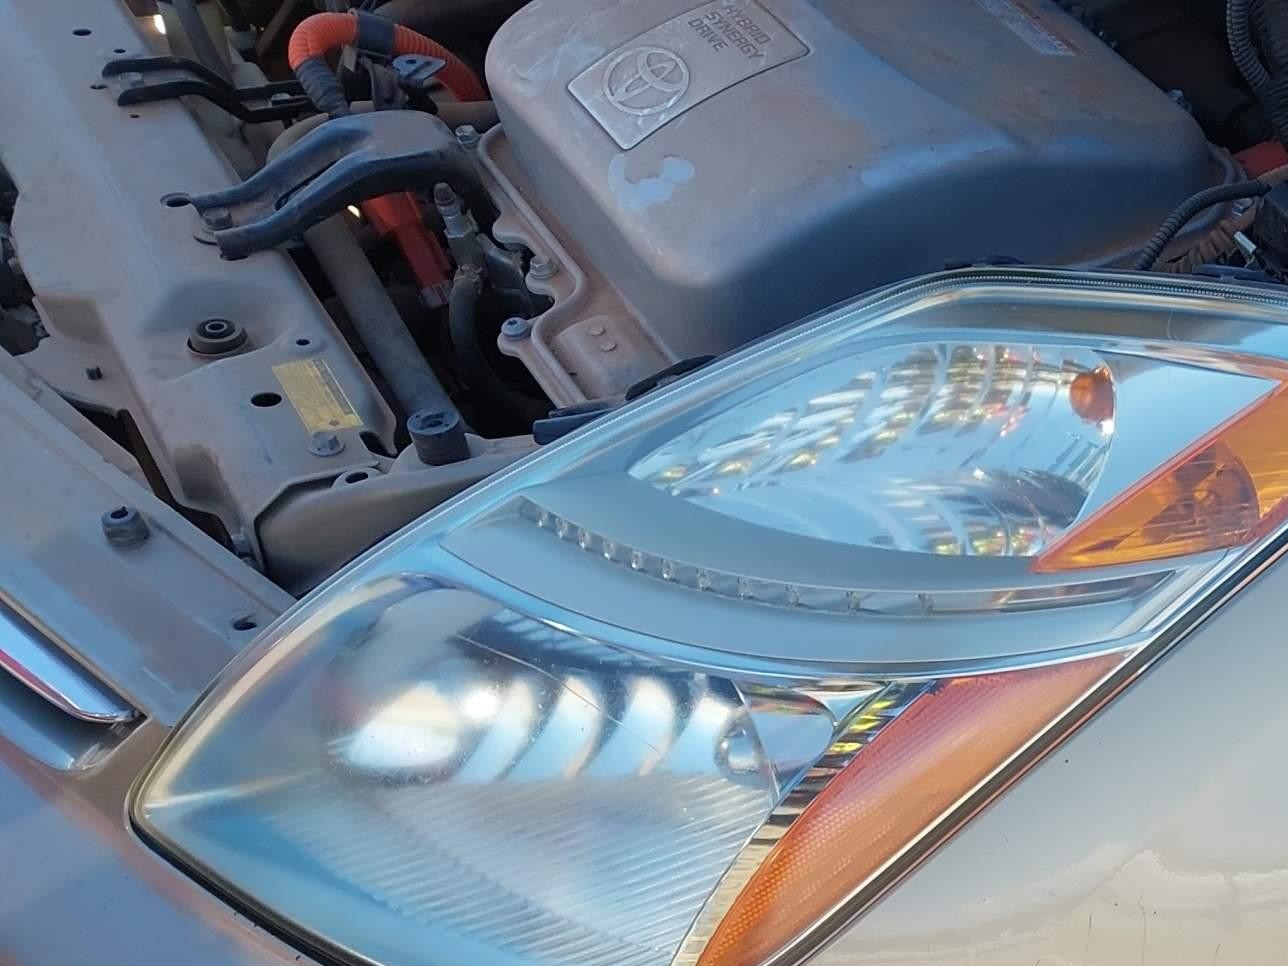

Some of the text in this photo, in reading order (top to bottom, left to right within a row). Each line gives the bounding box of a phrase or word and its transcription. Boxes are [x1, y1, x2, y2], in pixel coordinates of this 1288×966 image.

[688, 18, 729, 52] DRIVE
[705, 11, 764, 59] SYNERGY
[722, 4, 771, 45] HYBRID
